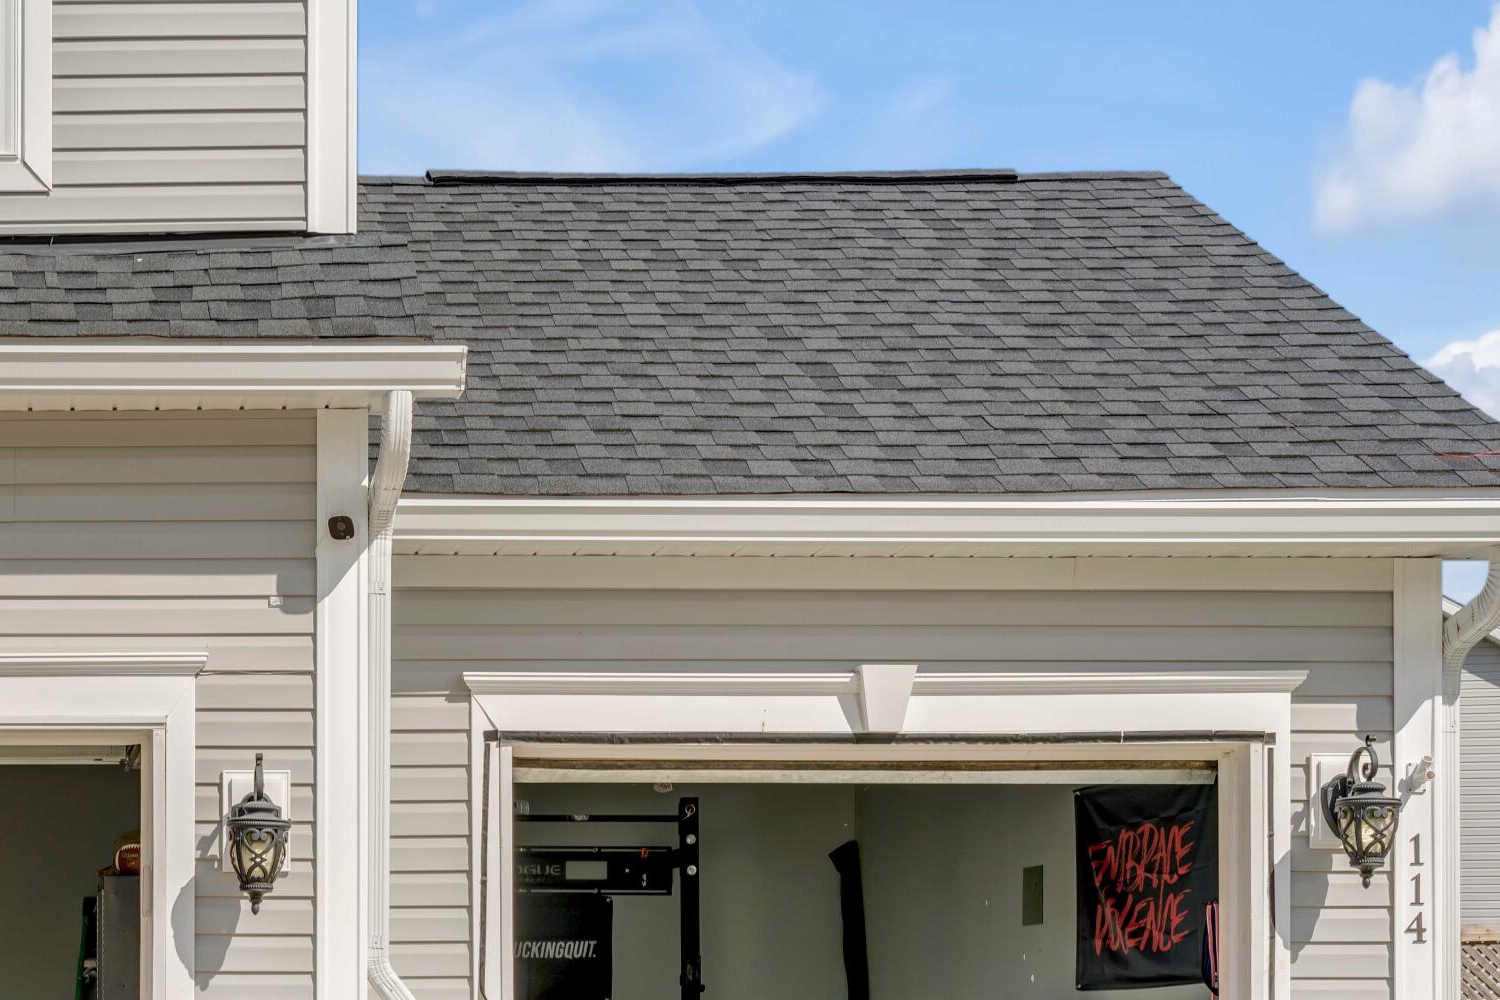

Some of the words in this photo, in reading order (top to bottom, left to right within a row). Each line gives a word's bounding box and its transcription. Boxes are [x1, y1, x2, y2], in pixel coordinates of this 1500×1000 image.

[1089, 821, 1195, 893] EMBRACE
[513, 940, 598, 959] UCKINGQUIT.
[1094, 889, 1192, 956] VIOLENCE
